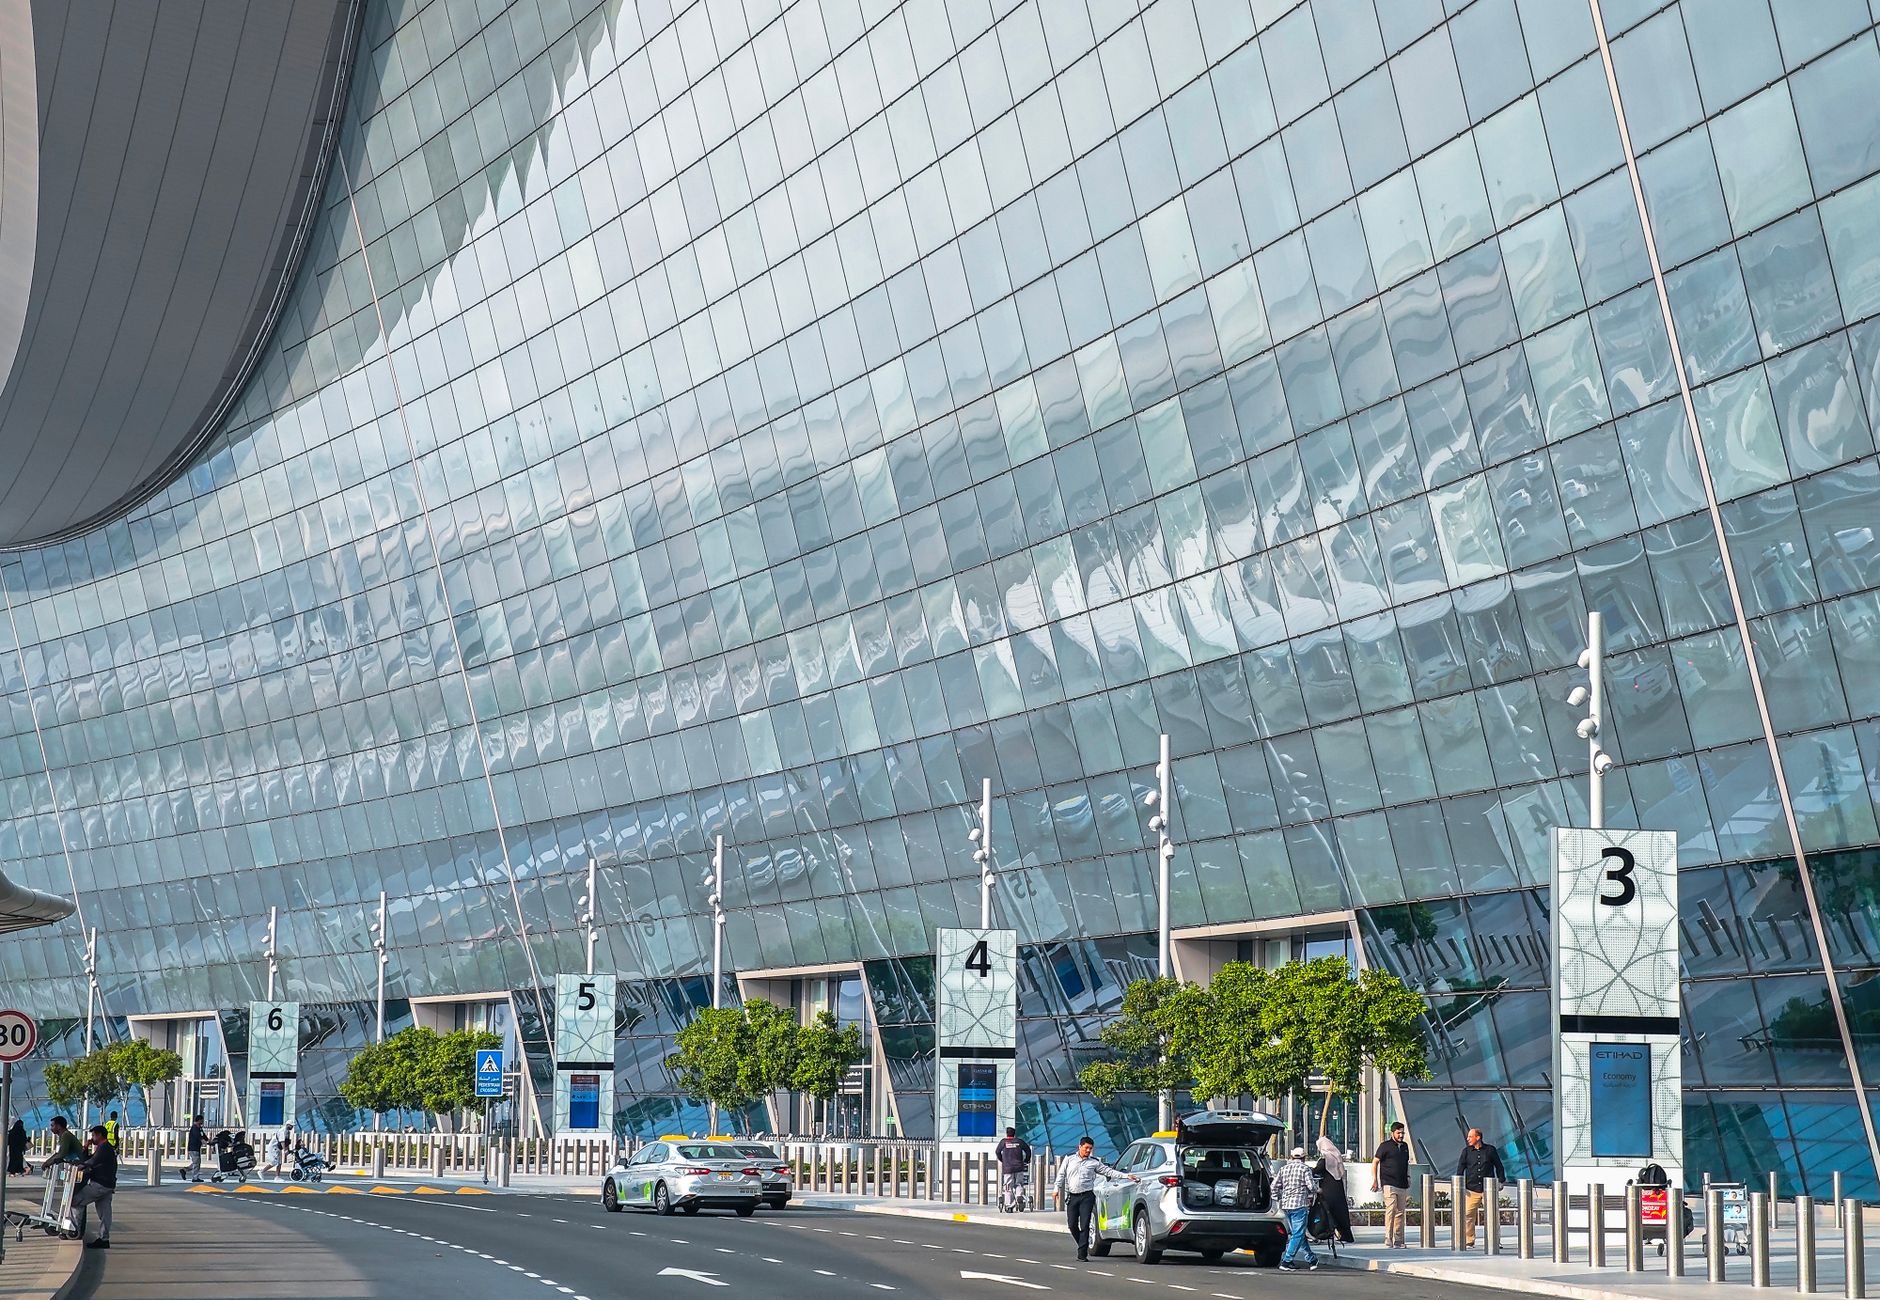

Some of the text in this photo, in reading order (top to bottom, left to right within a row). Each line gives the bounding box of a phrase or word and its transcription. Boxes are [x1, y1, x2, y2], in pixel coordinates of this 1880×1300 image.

[1600, 847, 1636, 907] 3
[965, 940, 992, 977] 4
[578, 983, 596, 1011] 5
[268, 1007, 283, 1031] 6
[1595, 1051, 1643, 1060] ETIHAD
[1602, 1072, 1637, 1082] Economy
